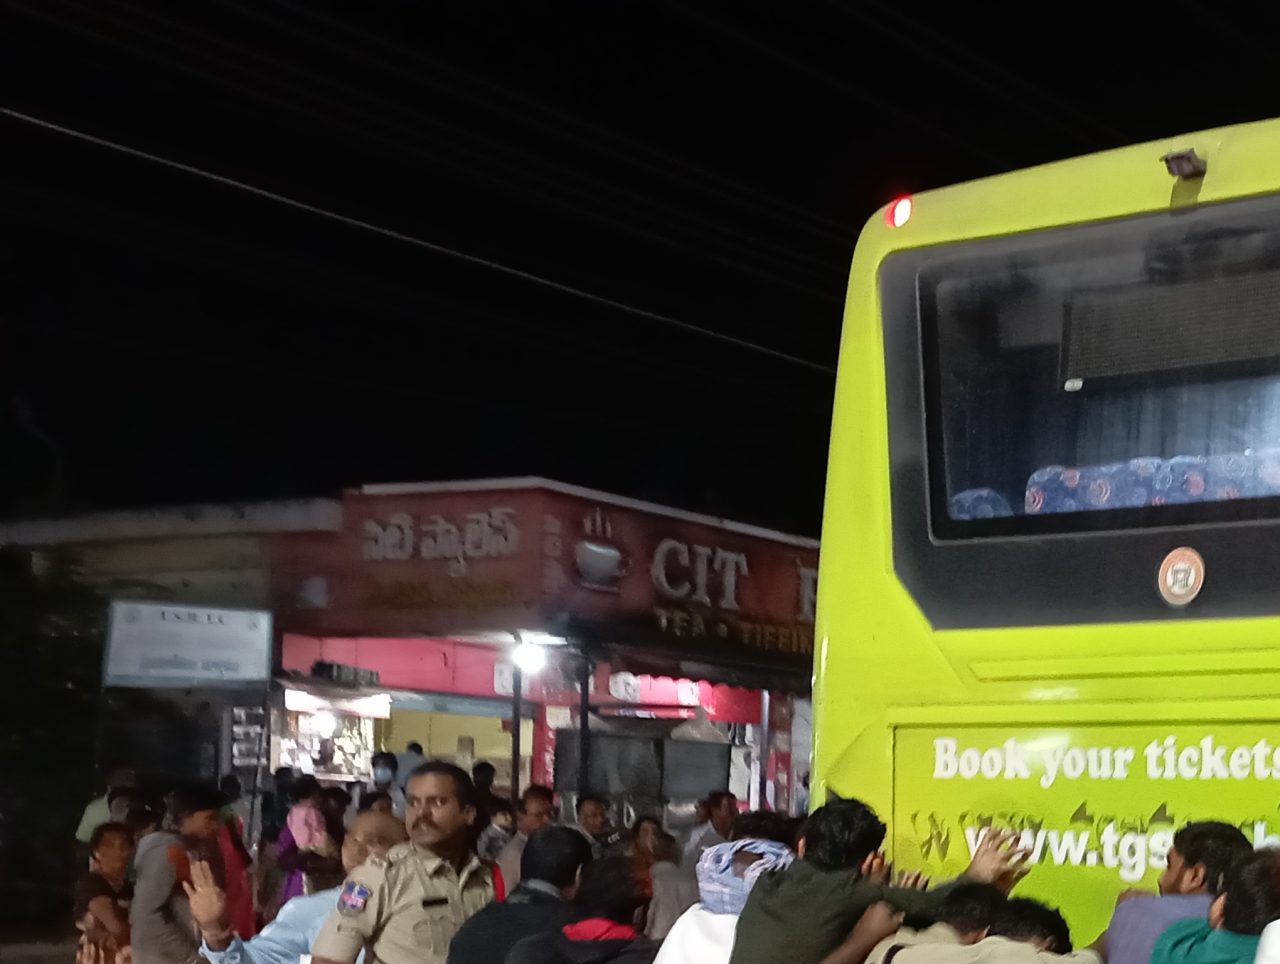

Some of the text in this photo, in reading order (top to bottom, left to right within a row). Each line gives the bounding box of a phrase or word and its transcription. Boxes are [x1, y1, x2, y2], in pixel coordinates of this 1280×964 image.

[653, 538, 748, 610] CIT
[933, 737, 1030, 779] Book
[1038, 746, 1134, 789] your
